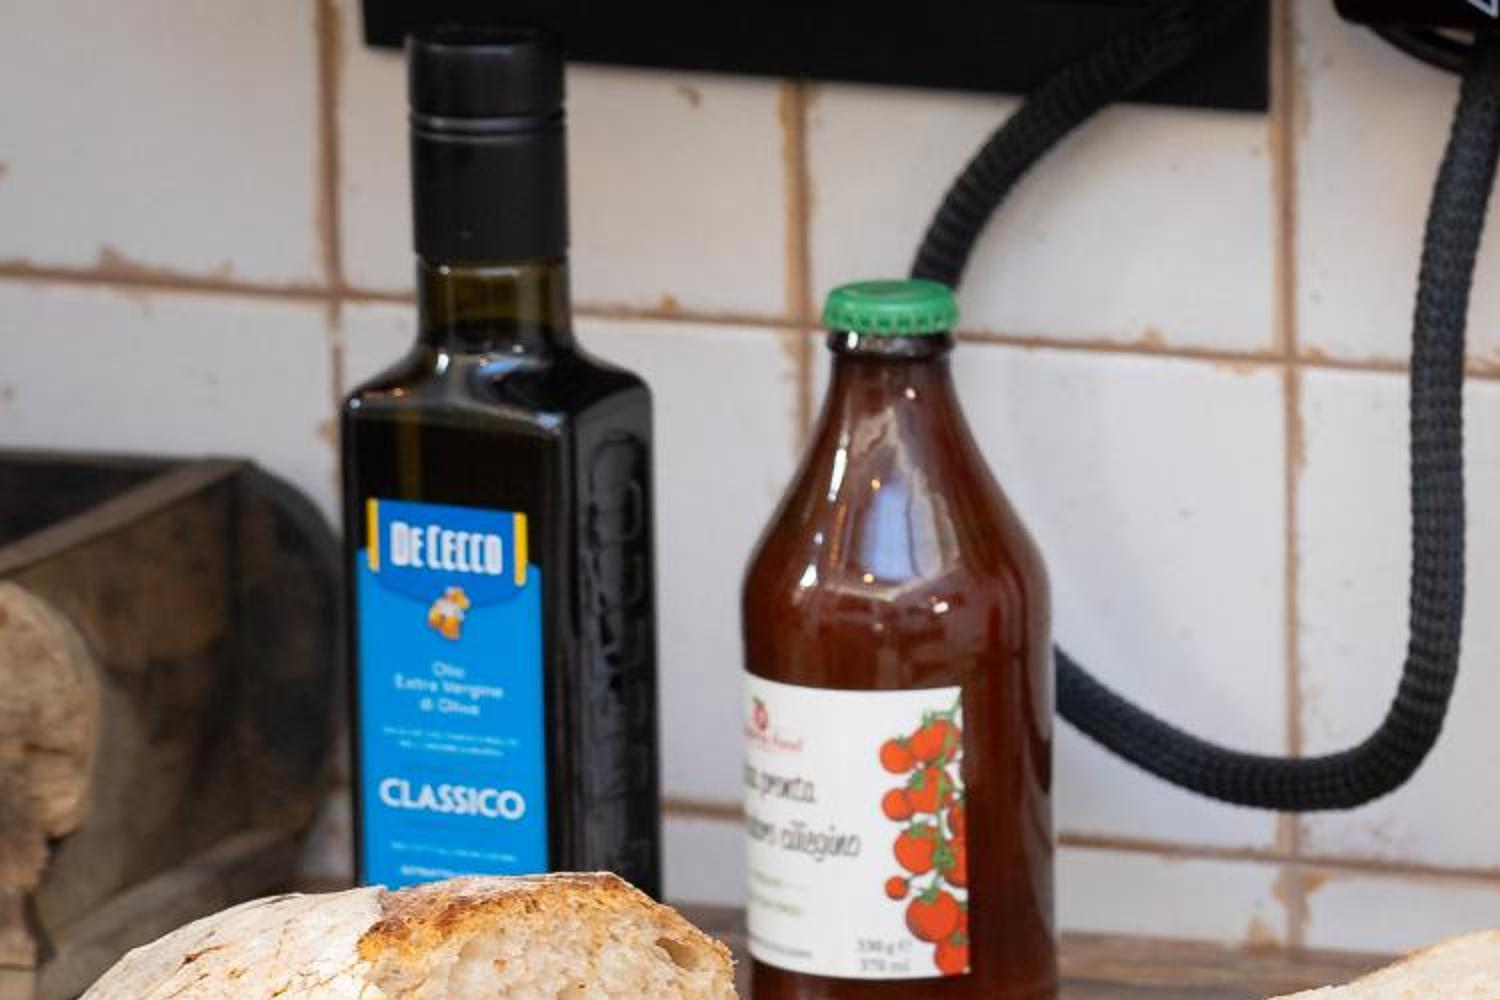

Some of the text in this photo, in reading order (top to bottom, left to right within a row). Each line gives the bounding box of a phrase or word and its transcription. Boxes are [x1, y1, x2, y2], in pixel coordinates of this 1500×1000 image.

[394, 673, 505, 700] Extra Vergine
[378, 777, 526, 821] CLASSICO
